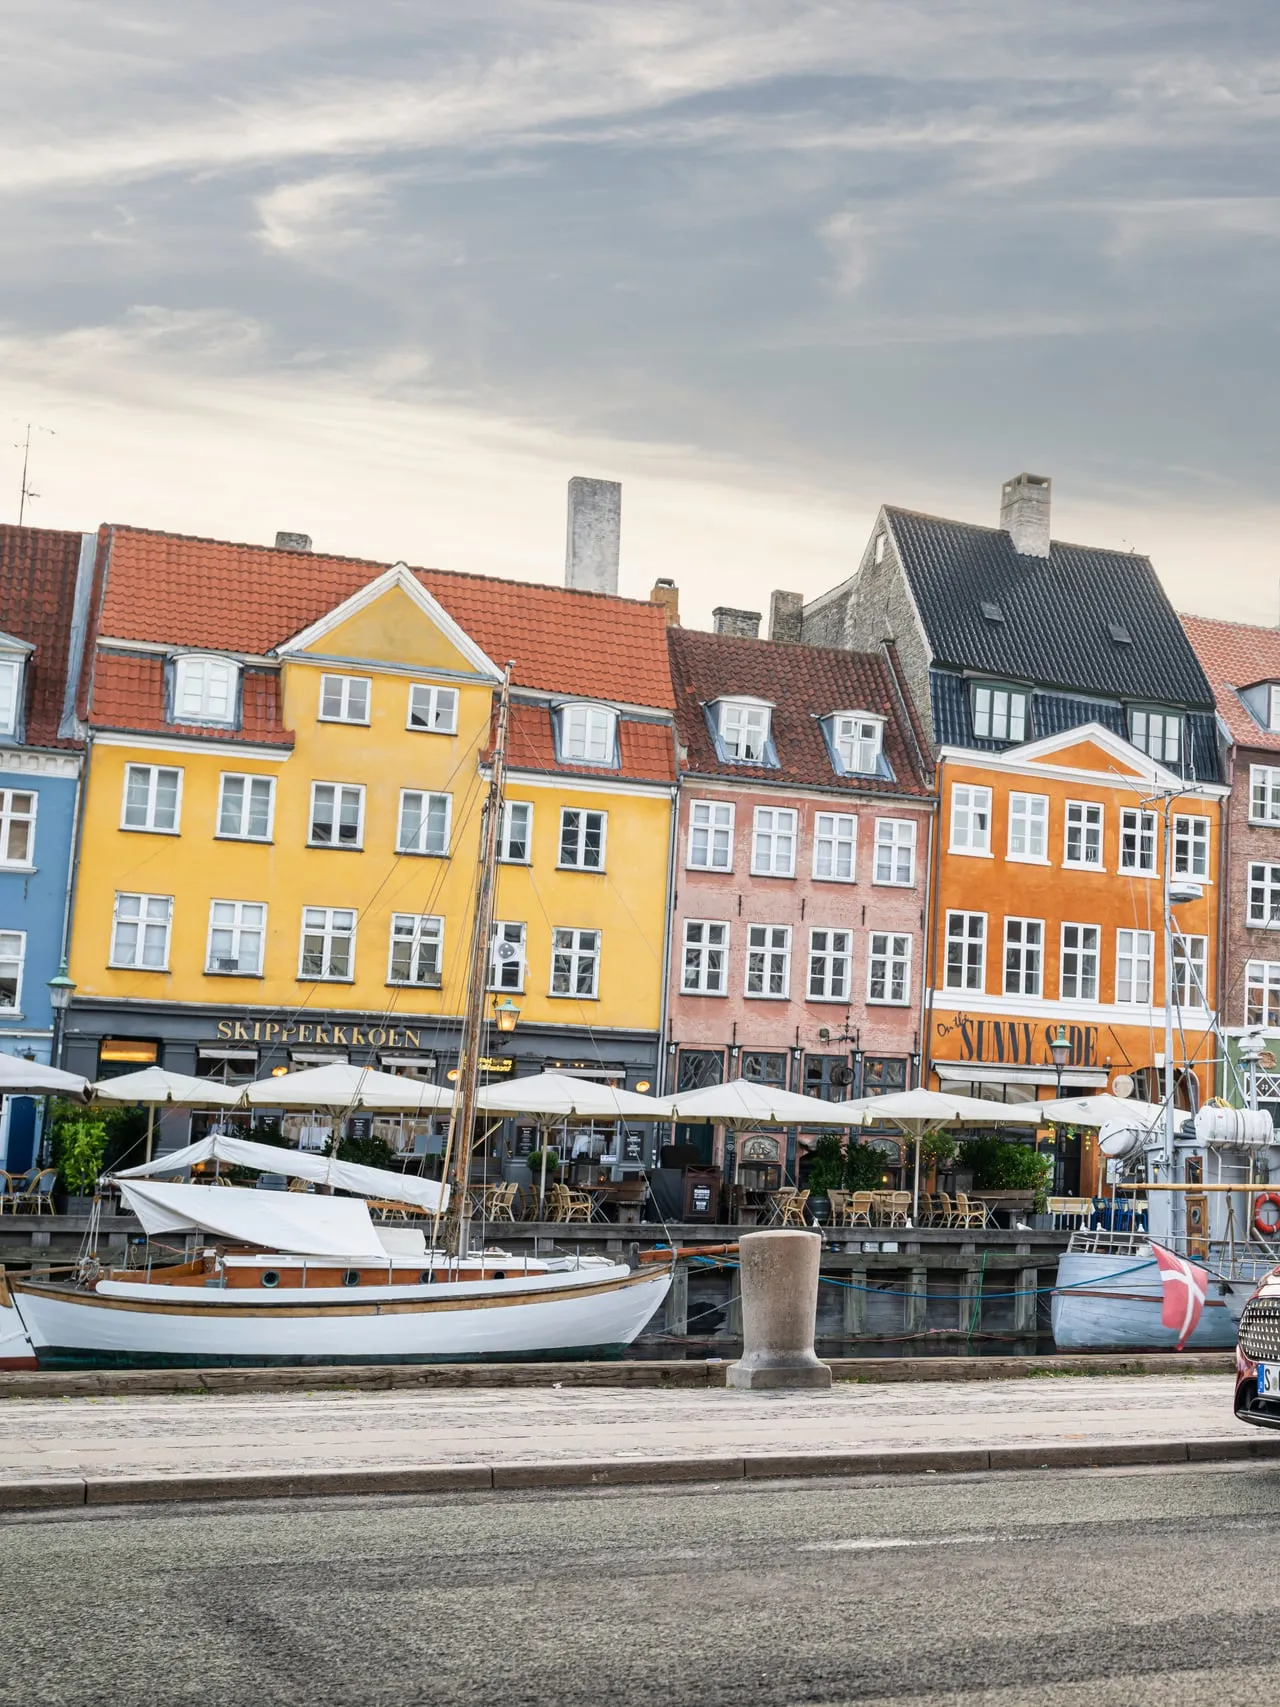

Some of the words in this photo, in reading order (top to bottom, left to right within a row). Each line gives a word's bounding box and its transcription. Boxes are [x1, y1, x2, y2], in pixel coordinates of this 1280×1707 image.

[936, 1023, 954, 1038] On
[952, 1011, 970, 1028] the
[960, 1018, 1039, 1065] SUNNY
[1044, 1023, 1099, 1068] SDE
[1264, 1368, 1271, 1391] S
